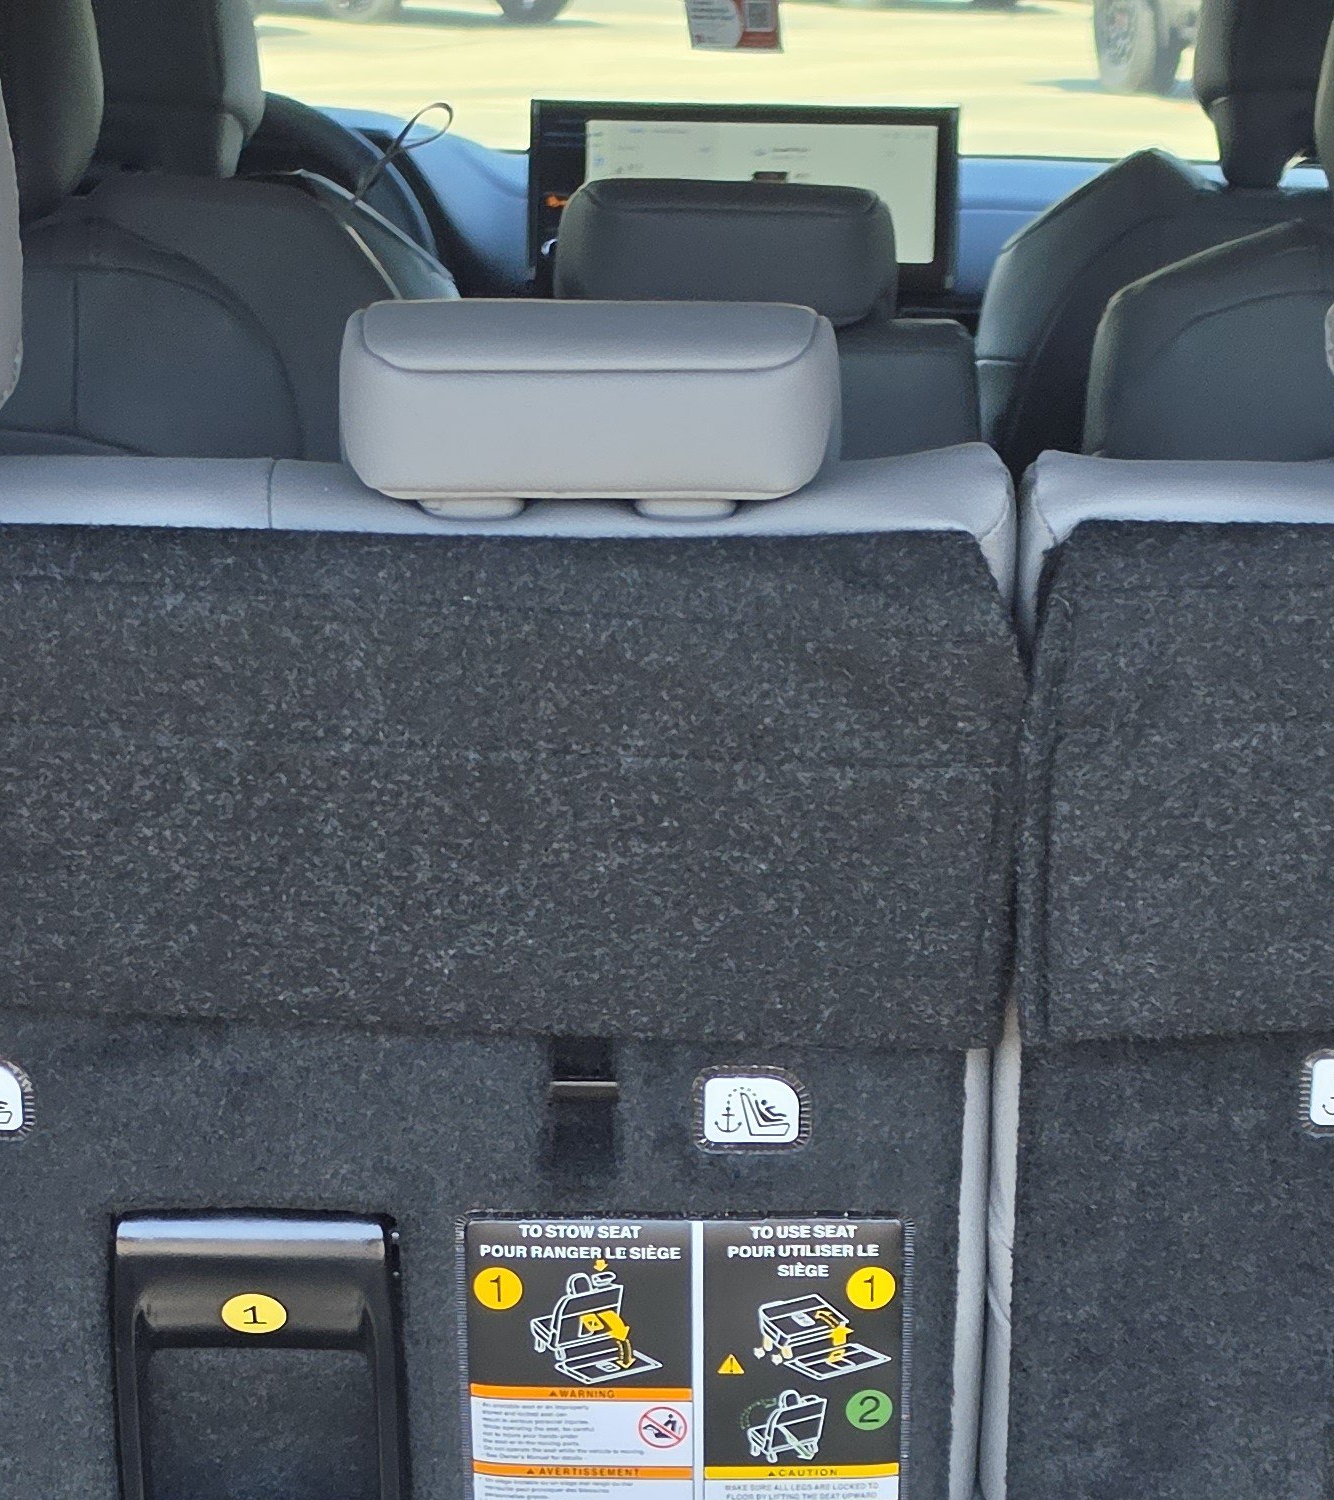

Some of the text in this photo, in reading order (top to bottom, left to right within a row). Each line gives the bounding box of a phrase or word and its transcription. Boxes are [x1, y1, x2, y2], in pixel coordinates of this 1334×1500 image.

[519, 1224, 642, 1239] TO STOW SEAT
[749, 1225, 858, 1240] TO USE SEAT
[480, 1244, 681, 1260] POUR RANGER LE SIÈGE
[727, 1244, 880, 1259] POUR UTILISER LE
[777, 1261, 829, 1277] SIÈGE
[490, 1275, 501, 1302] 1
[864, 1275, 875, 1302] 1
[243, 1306, 267, 1324] 1
[559, 1389, 615, 1399] WARNING
[859, 1395, 881, 1423] 2
[539, 1468, 640, 1477] AVERTISSEMENT
[779, 1469, 838, 1477] CAUTION
